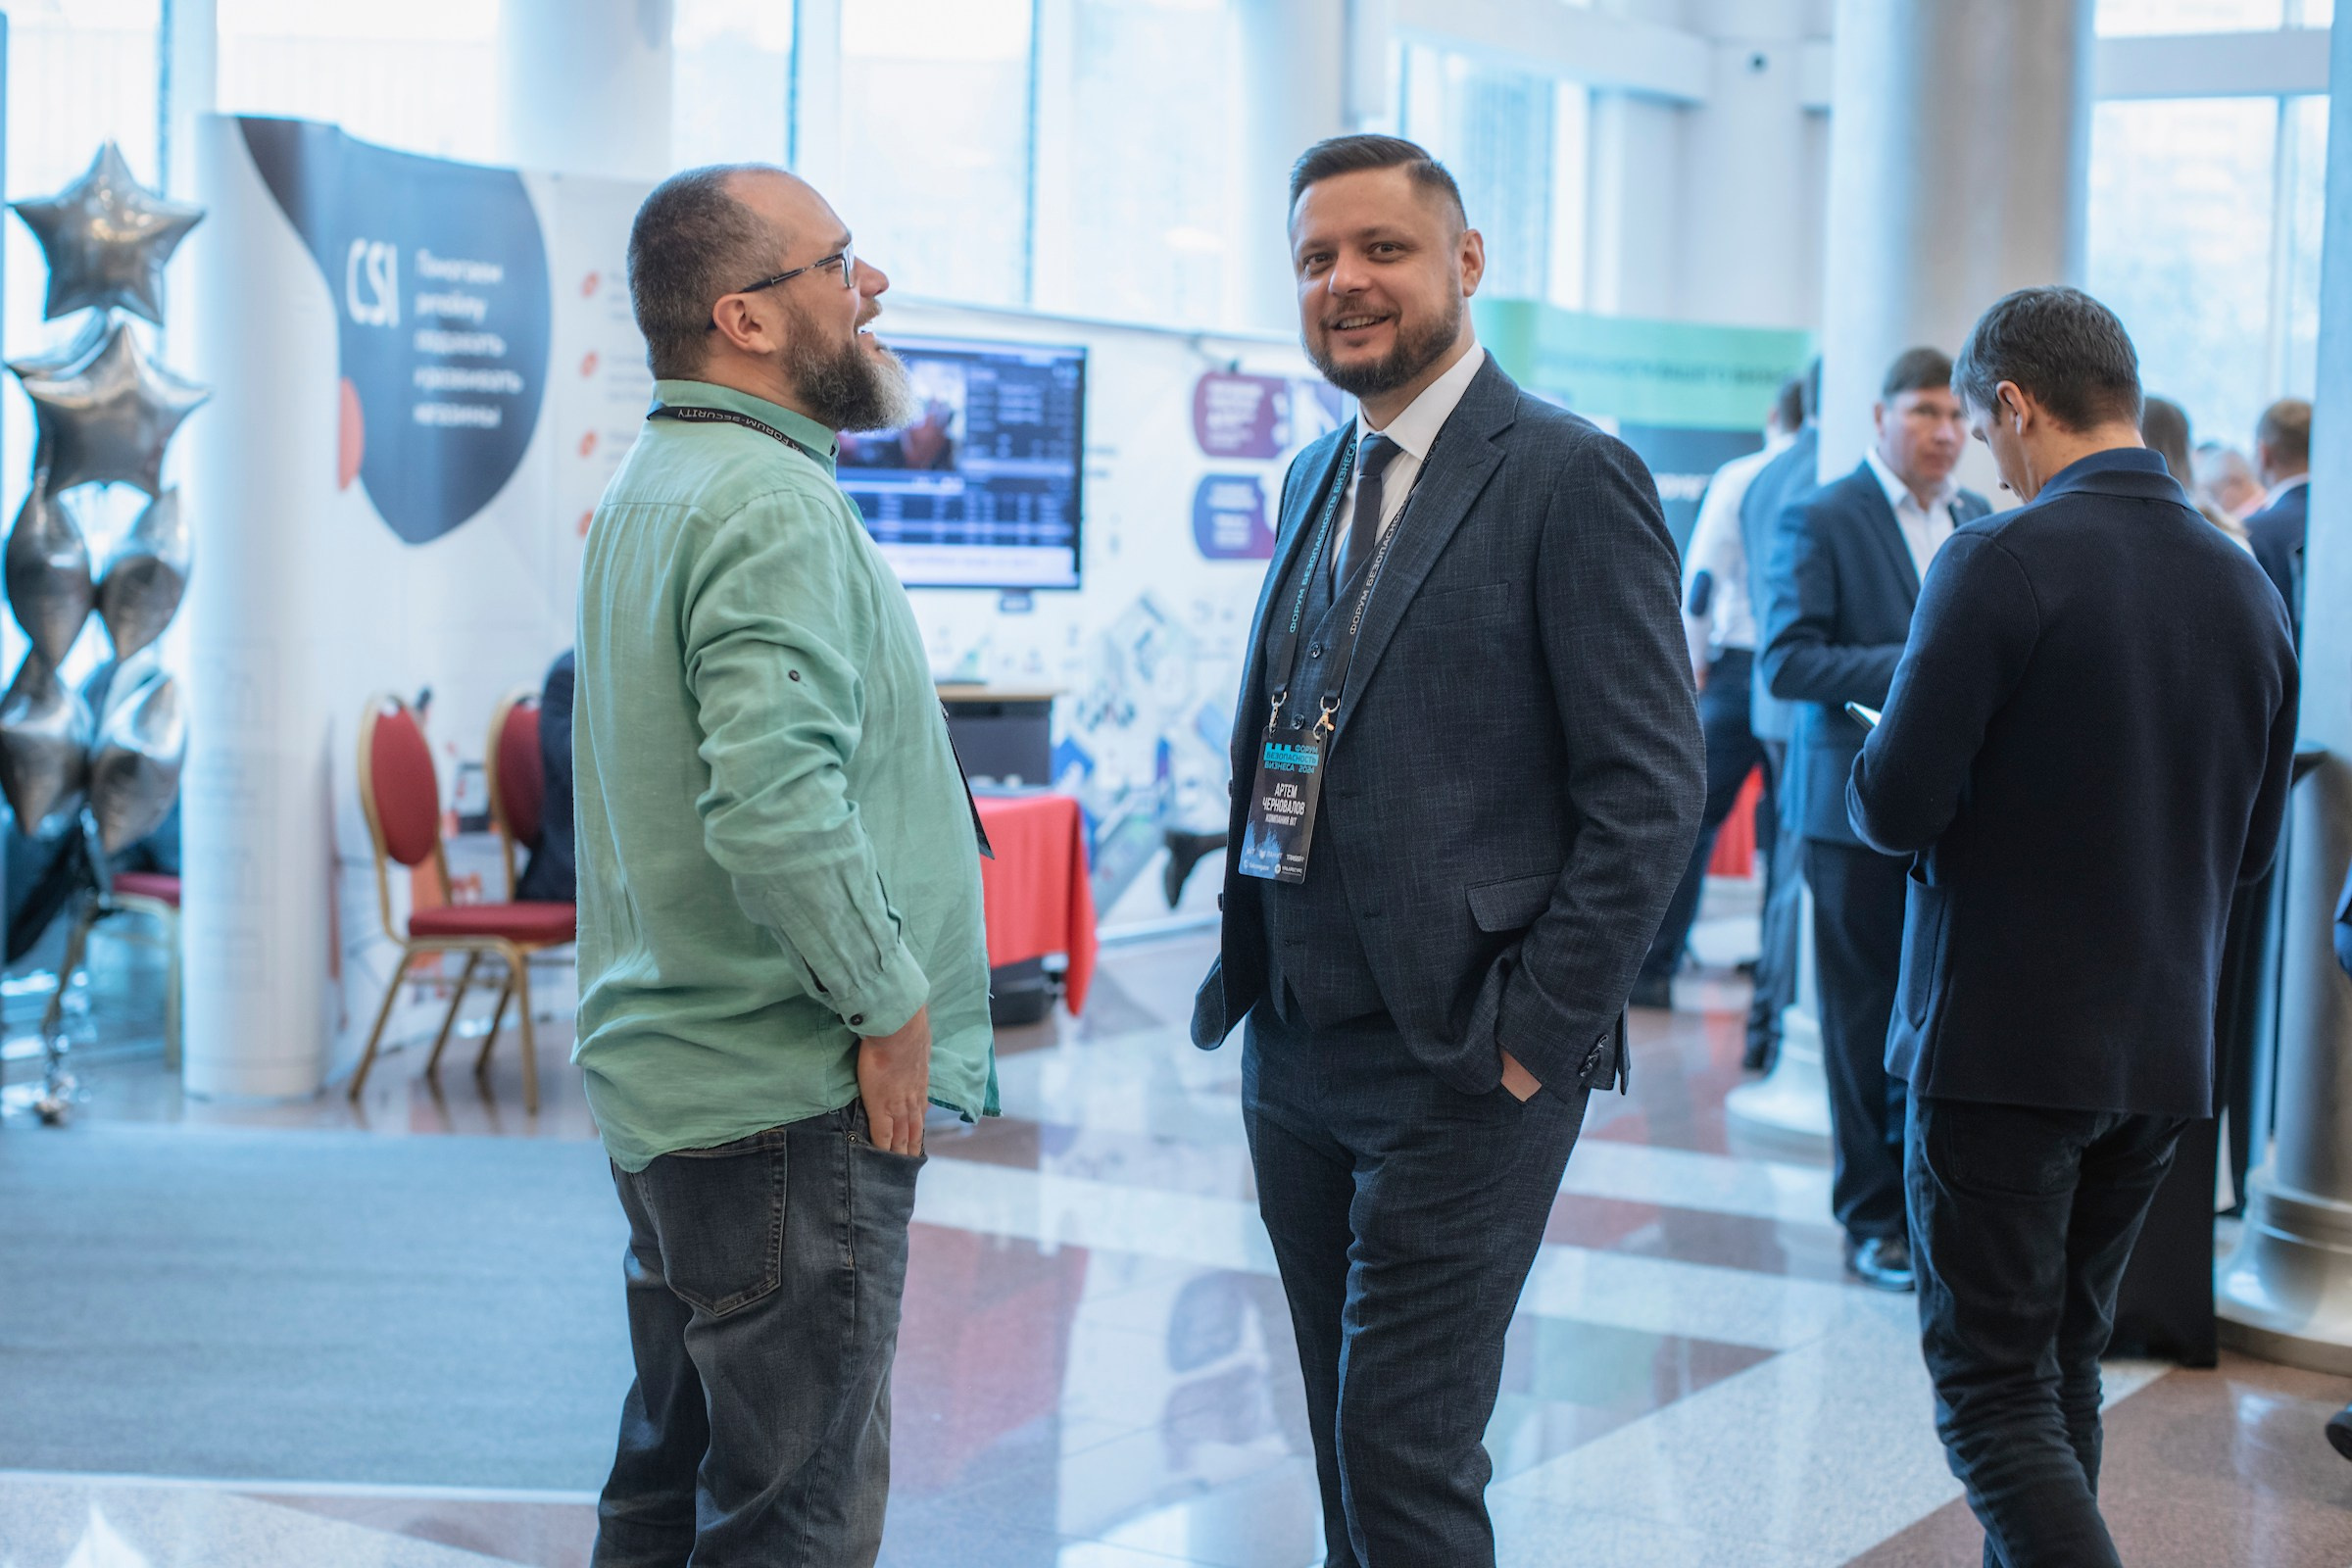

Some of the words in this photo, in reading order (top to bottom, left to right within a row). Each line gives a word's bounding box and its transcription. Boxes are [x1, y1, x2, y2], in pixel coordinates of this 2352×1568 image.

[347, 238, 400, 328] CSI
[677, 408, 790, 447] FORUM-SECURITY
[1289, 588, 1305, 633] ФОРУМ
[1301, 496, 1337, 586] БЕЗОПАСНОСТЬ
[1333, 443, 1356, 494] БИЗНЕСА
[1349, 589, 1369, 635] ФОРУМ
[1266, 751, 1317, 764] БЕЗОПАСНОСТЬ
[1295, 744, 1318, 754] ФОРУМ
[1264, 761, 1295, 772] БИЗНЕСА
[1298, 764, 1315, 774] 2024
[1274, 782, 1298, 799] АРТЕМ
[1262, 796, 1305, 815] ЧЕРНОВАЛОВ
